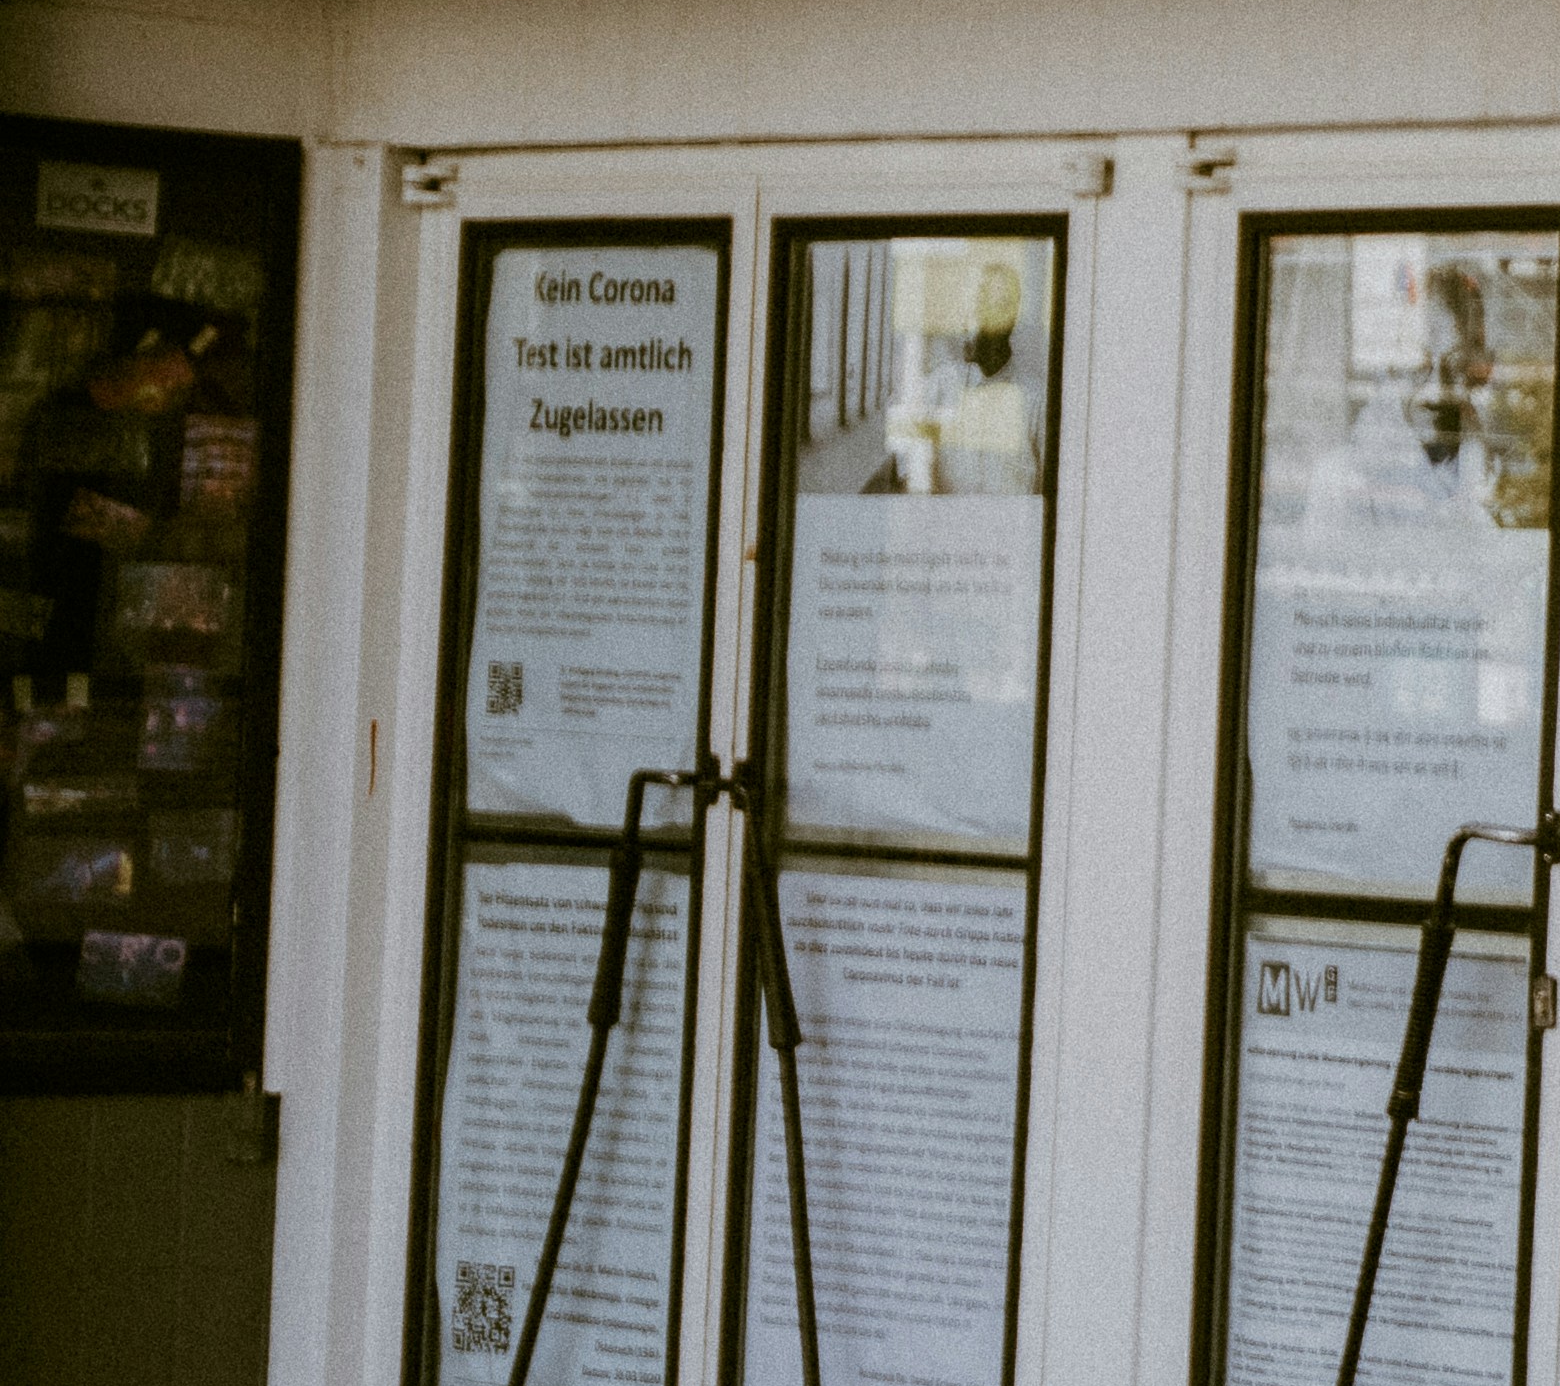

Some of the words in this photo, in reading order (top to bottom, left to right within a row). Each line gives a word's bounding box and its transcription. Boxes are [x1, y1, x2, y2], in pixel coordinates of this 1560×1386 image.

[588, 271, 676, 305] Corona
[512, 336, 559, 370] Test
[565, 334, 593, 370] ist
[600, 335, 693, 371] amtlich
[529, 398, 664, 440] Zugelassen
